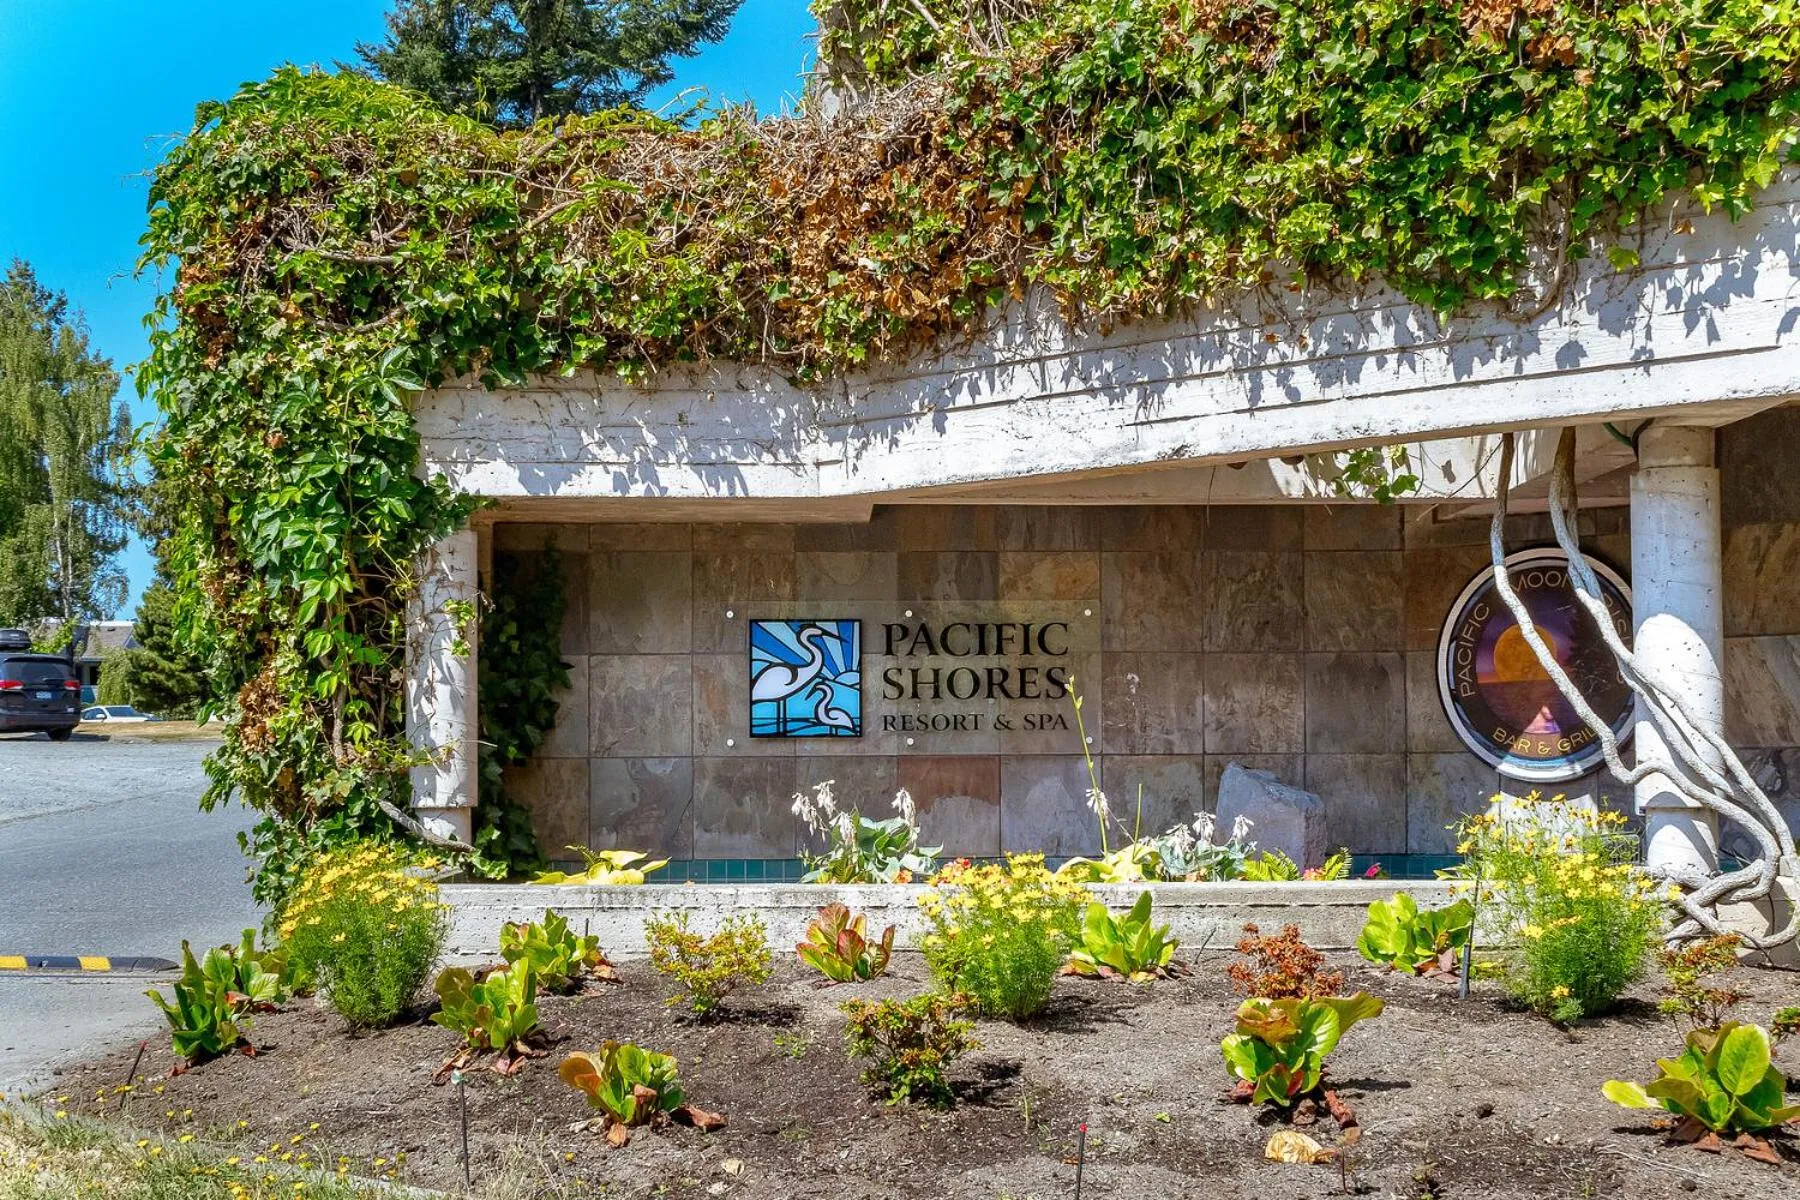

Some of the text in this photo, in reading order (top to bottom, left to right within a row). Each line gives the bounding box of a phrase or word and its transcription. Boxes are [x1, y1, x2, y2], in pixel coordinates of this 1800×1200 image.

[882, 622, 1069, 657] PACIFIC
[1457, 602, 1490, 697] PACIFIC
[882, 666, 1068, 701] SHORES
[883, 713, 1069, 732] RESORT & SPA
[1493, 727, 1600, 754] BAR & GRIL
